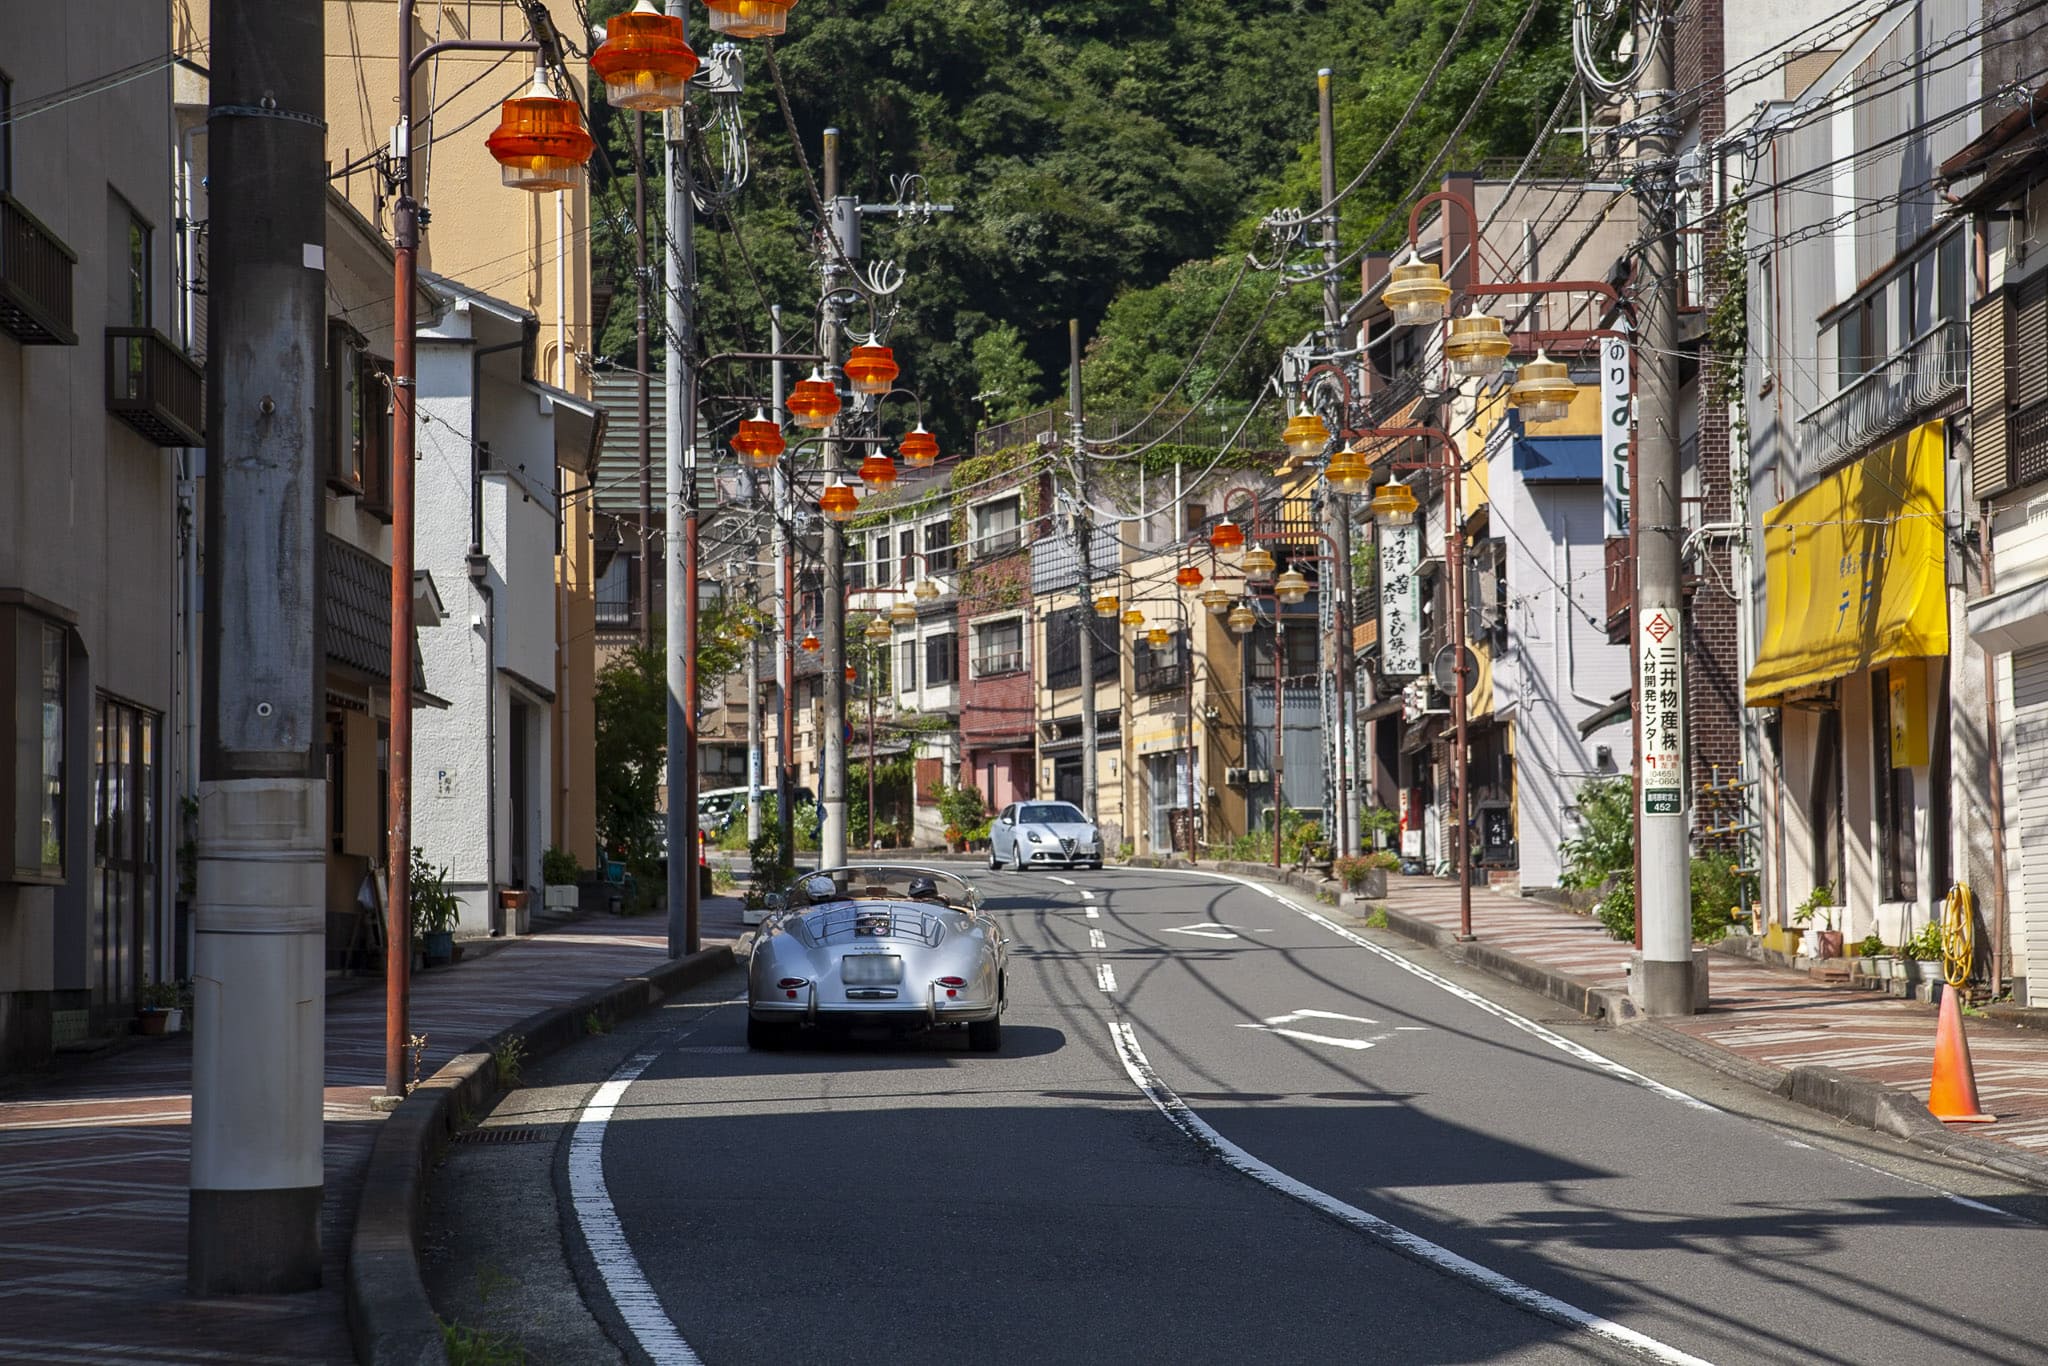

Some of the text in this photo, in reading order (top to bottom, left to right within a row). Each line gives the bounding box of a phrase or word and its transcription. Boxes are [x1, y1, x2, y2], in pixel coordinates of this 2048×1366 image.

[1610, 344, 1625, 384] のり
[1644, 647, 1657, 751] 人材開発センター
[1659, 648, 1679, 751] 三井物産株
[438, 770, 447, 781] P
[1653, 803, 1671, 812] 452
